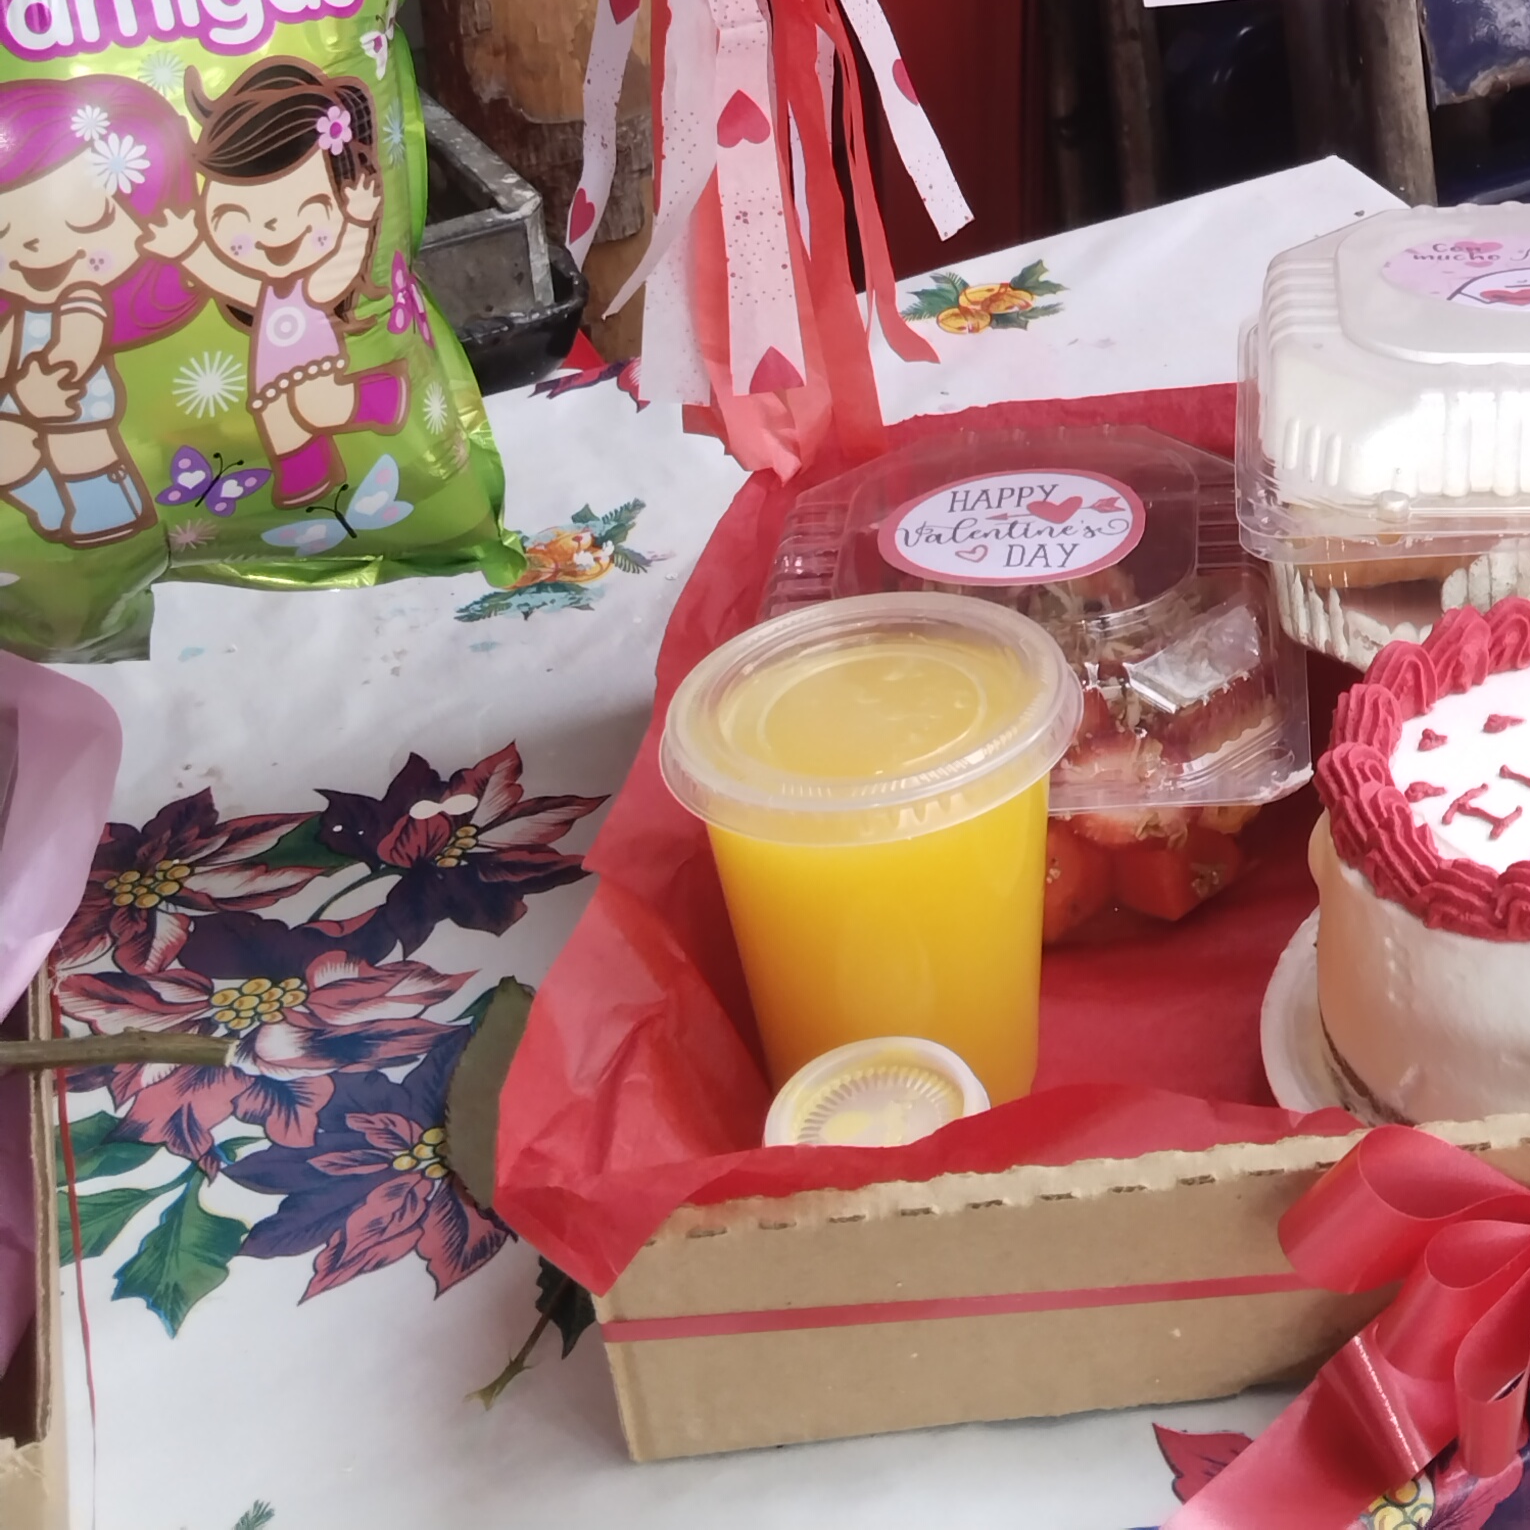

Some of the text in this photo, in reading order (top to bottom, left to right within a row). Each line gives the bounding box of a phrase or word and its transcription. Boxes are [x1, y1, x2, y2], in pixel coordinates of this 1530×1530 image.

[1413, 248, 1502, 261] mucho
[948, 484, 1059, 513] HAPPY
[898, 518, 1130, 547] Valentine's
[1003, 543, 1080, 568] DAY
[1442, 783, 1523, 840] I
